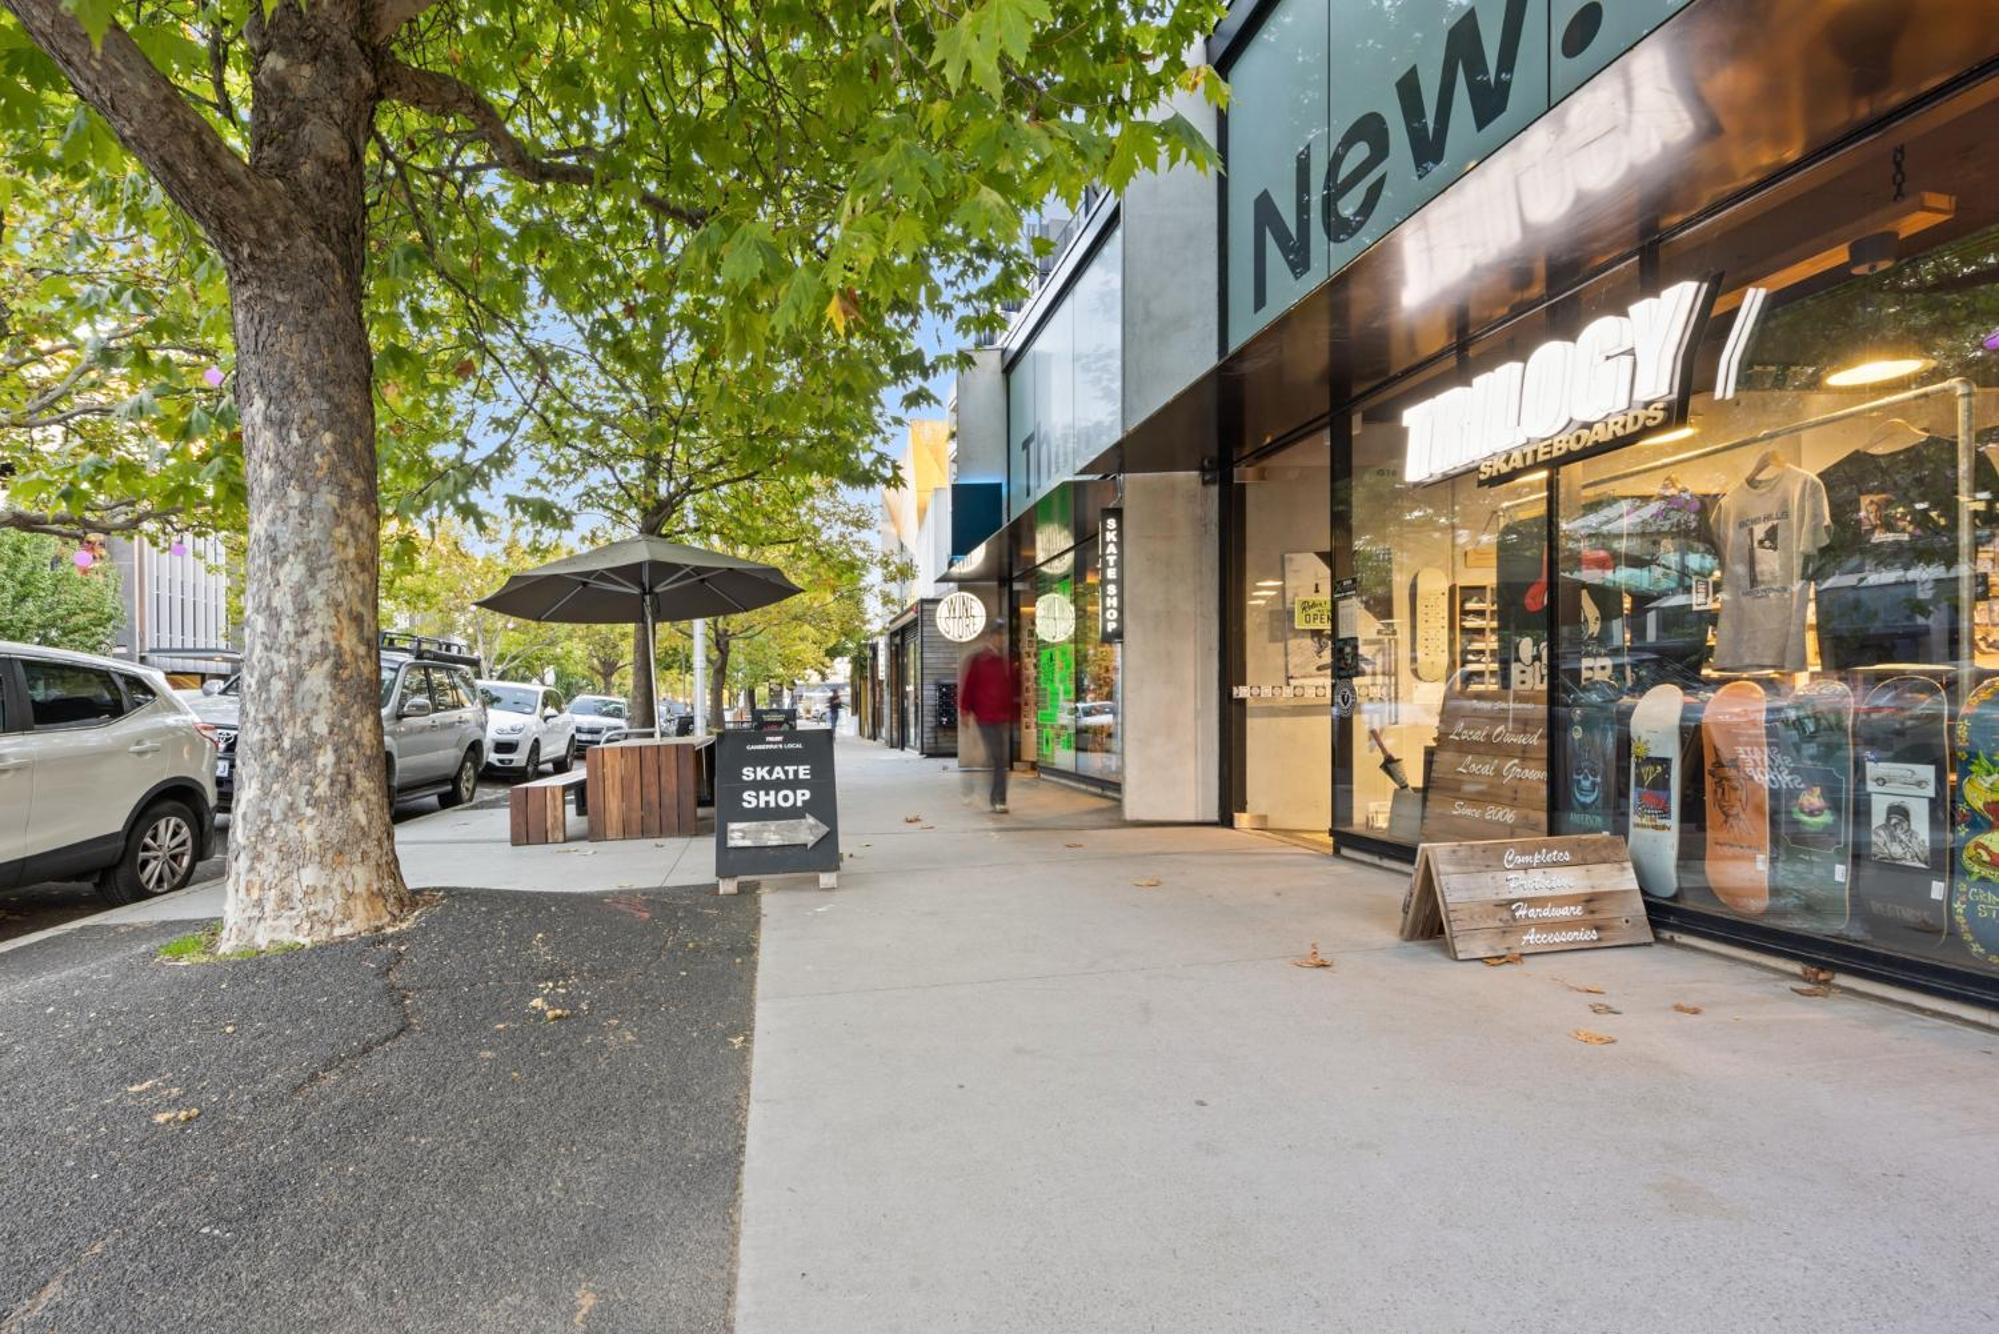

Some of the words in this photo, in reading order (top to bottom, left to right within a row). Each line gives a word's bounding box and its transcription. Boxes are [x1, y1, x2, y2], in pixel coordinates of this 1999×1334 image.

[1478, 402, 1668, 480] SKATEBOARDS
[1105, 518, 1118, 579] SKATE
[1105, 584, 1118, 632] SHOP
[1449, 721, 1489, 742] Local
[1491, 725, 1543, 745] Owned
[741, 765, 811, 781] SKATE
[1456, 755, 1498, 776] Local
[741, 789, 811, 808] SHOP
[1452, 801, 1482, 818] Since
[1485, 805, 1517, 823] 2006
[1504, 848, 1570, 869] Completes
[1511, 902, 1584, 919] Hardware
[1521, 927, 1599, 945] Accessories
